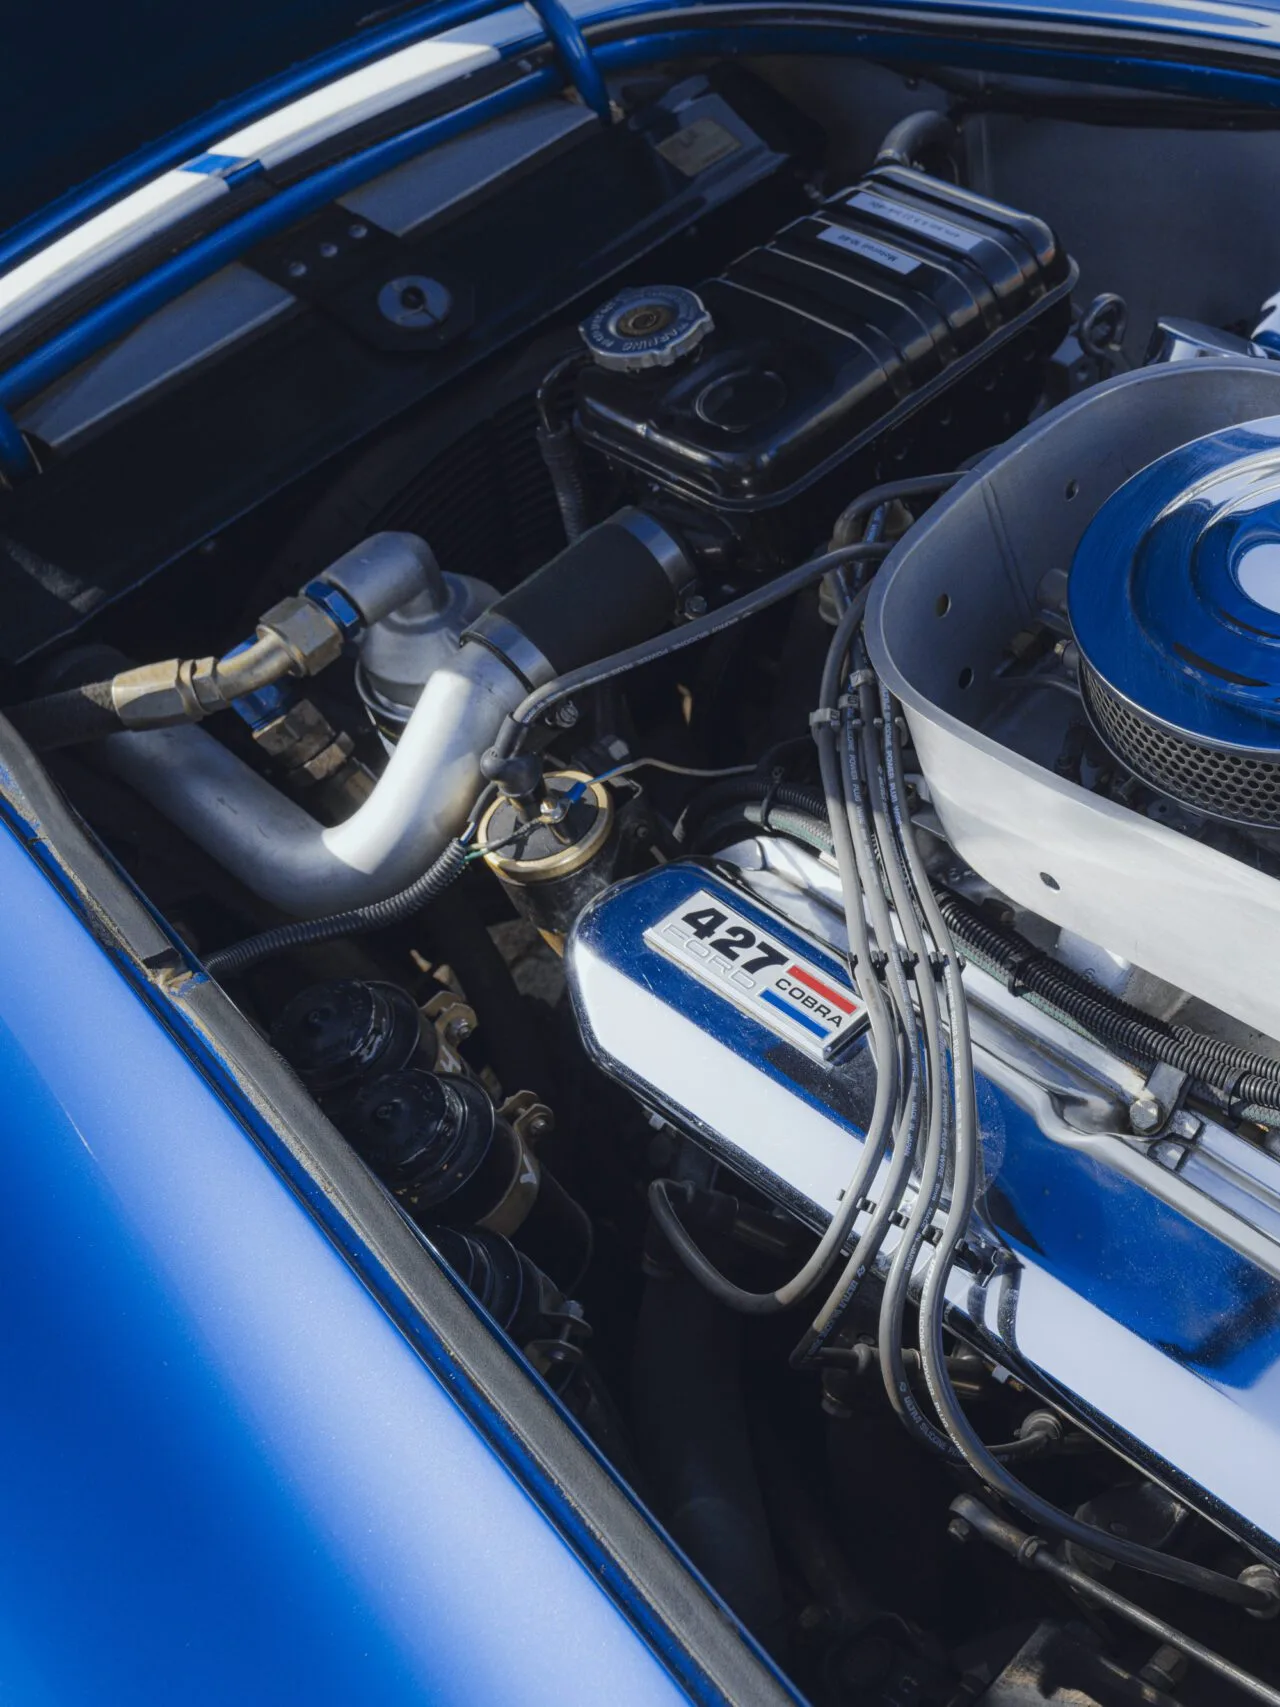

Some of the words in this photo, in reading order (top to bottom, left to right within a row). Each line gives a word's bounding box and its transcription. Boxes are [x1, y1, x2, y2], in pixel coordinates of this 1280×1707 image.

[848, 754, 858, 780] POWER
[885, 750, 895, 779] POWER
[852, 782, 862, 802] PLUG
[888, 781, 899, 802] PLUG
[681, 907, 790, 975] 427
[661, 923, 757, 990] FORD
[775, 978, 844, 1028] COBRA
[940, 1127, 948, 1149] PLUG
[936, 1154, 947, 1178] WIRE
[904, 1244, 917, 1270] JAPAN
[921, 1355, 935, 1396] POWER
[934, 1401, 949, 1428] PLUG
[949, 1431, 968, 1458] WIRE
[903, 1395, 923, 1424] ULTRA
[918, 1421, 948, 1450] SILICONE
